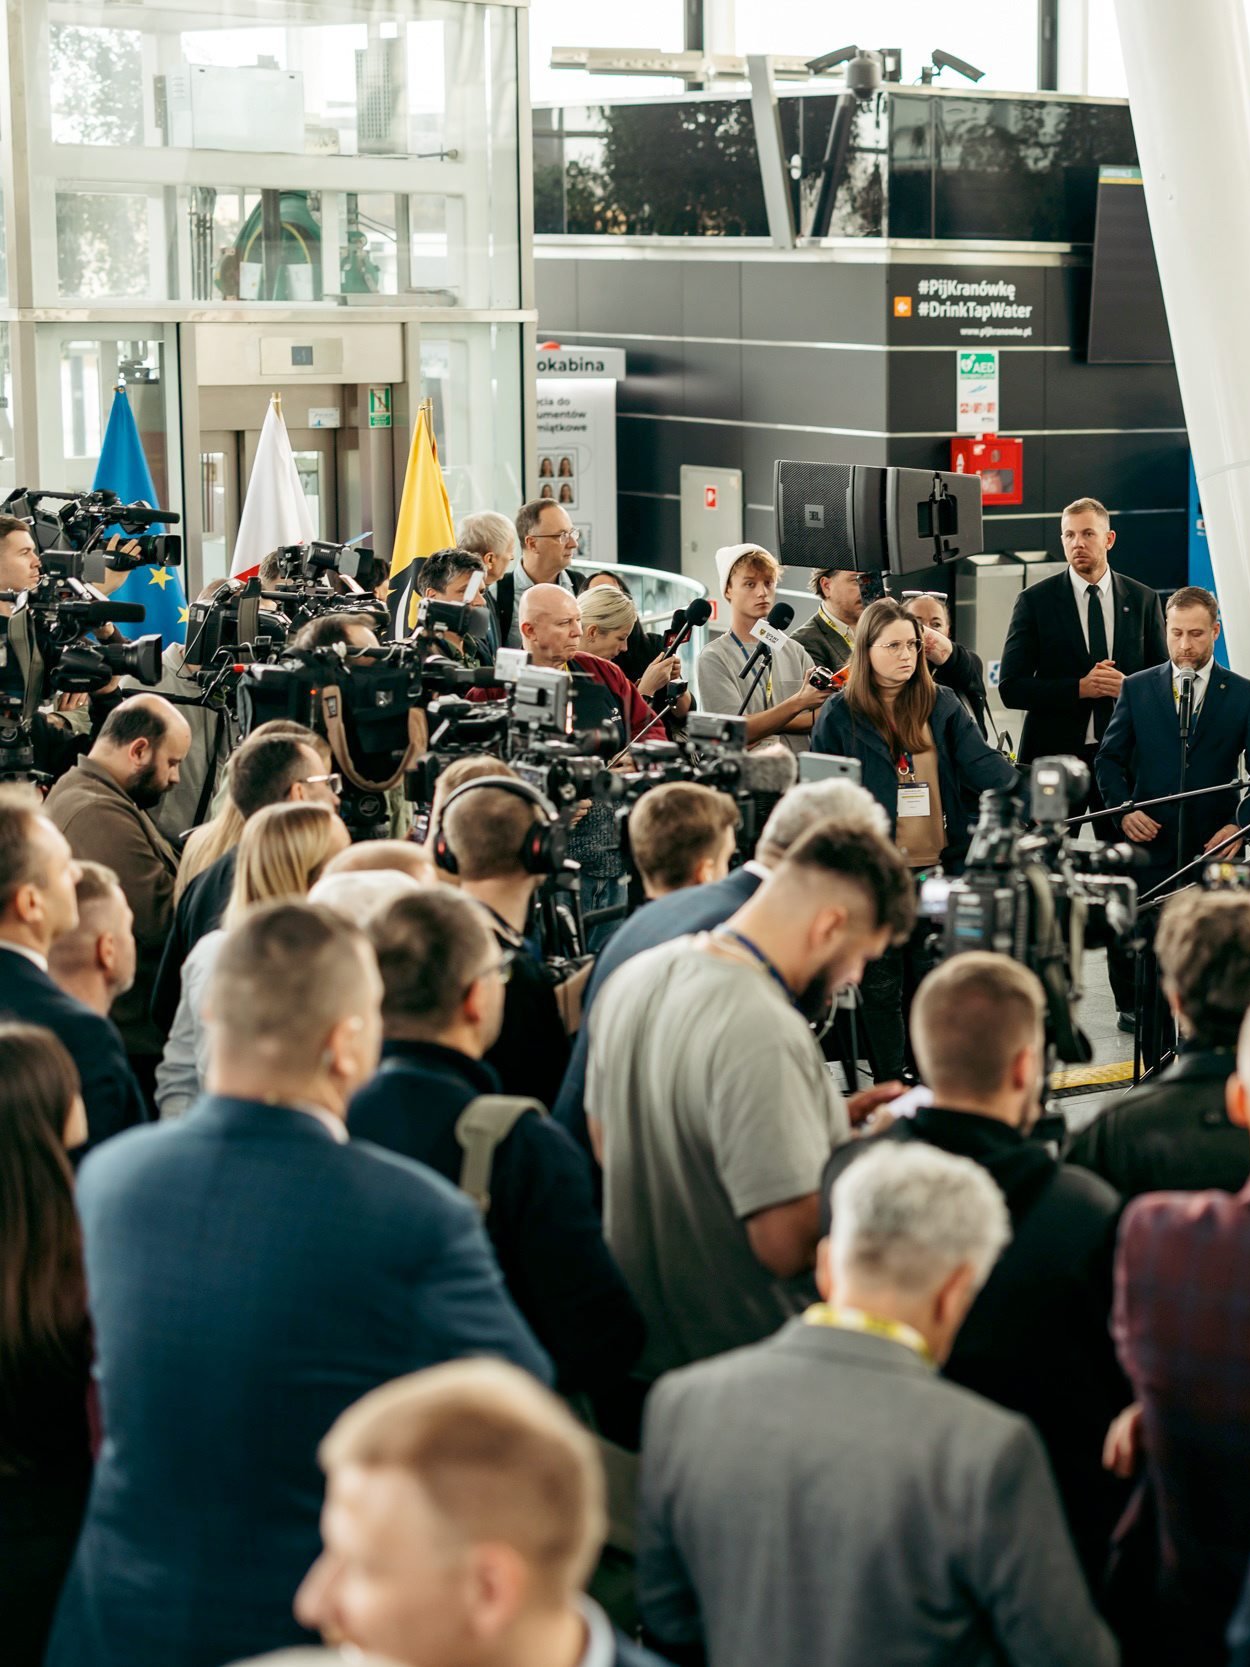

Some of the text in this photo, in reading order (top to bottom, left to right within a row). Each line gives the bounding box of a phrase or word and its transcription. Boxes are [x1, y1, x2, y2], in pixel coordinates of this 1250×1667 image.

[918, 279, 1016, 301] #PijKranówkę
[918, 301, 1033, 322] #DrinkTapWater
[972, 362, 995, 374] AED
